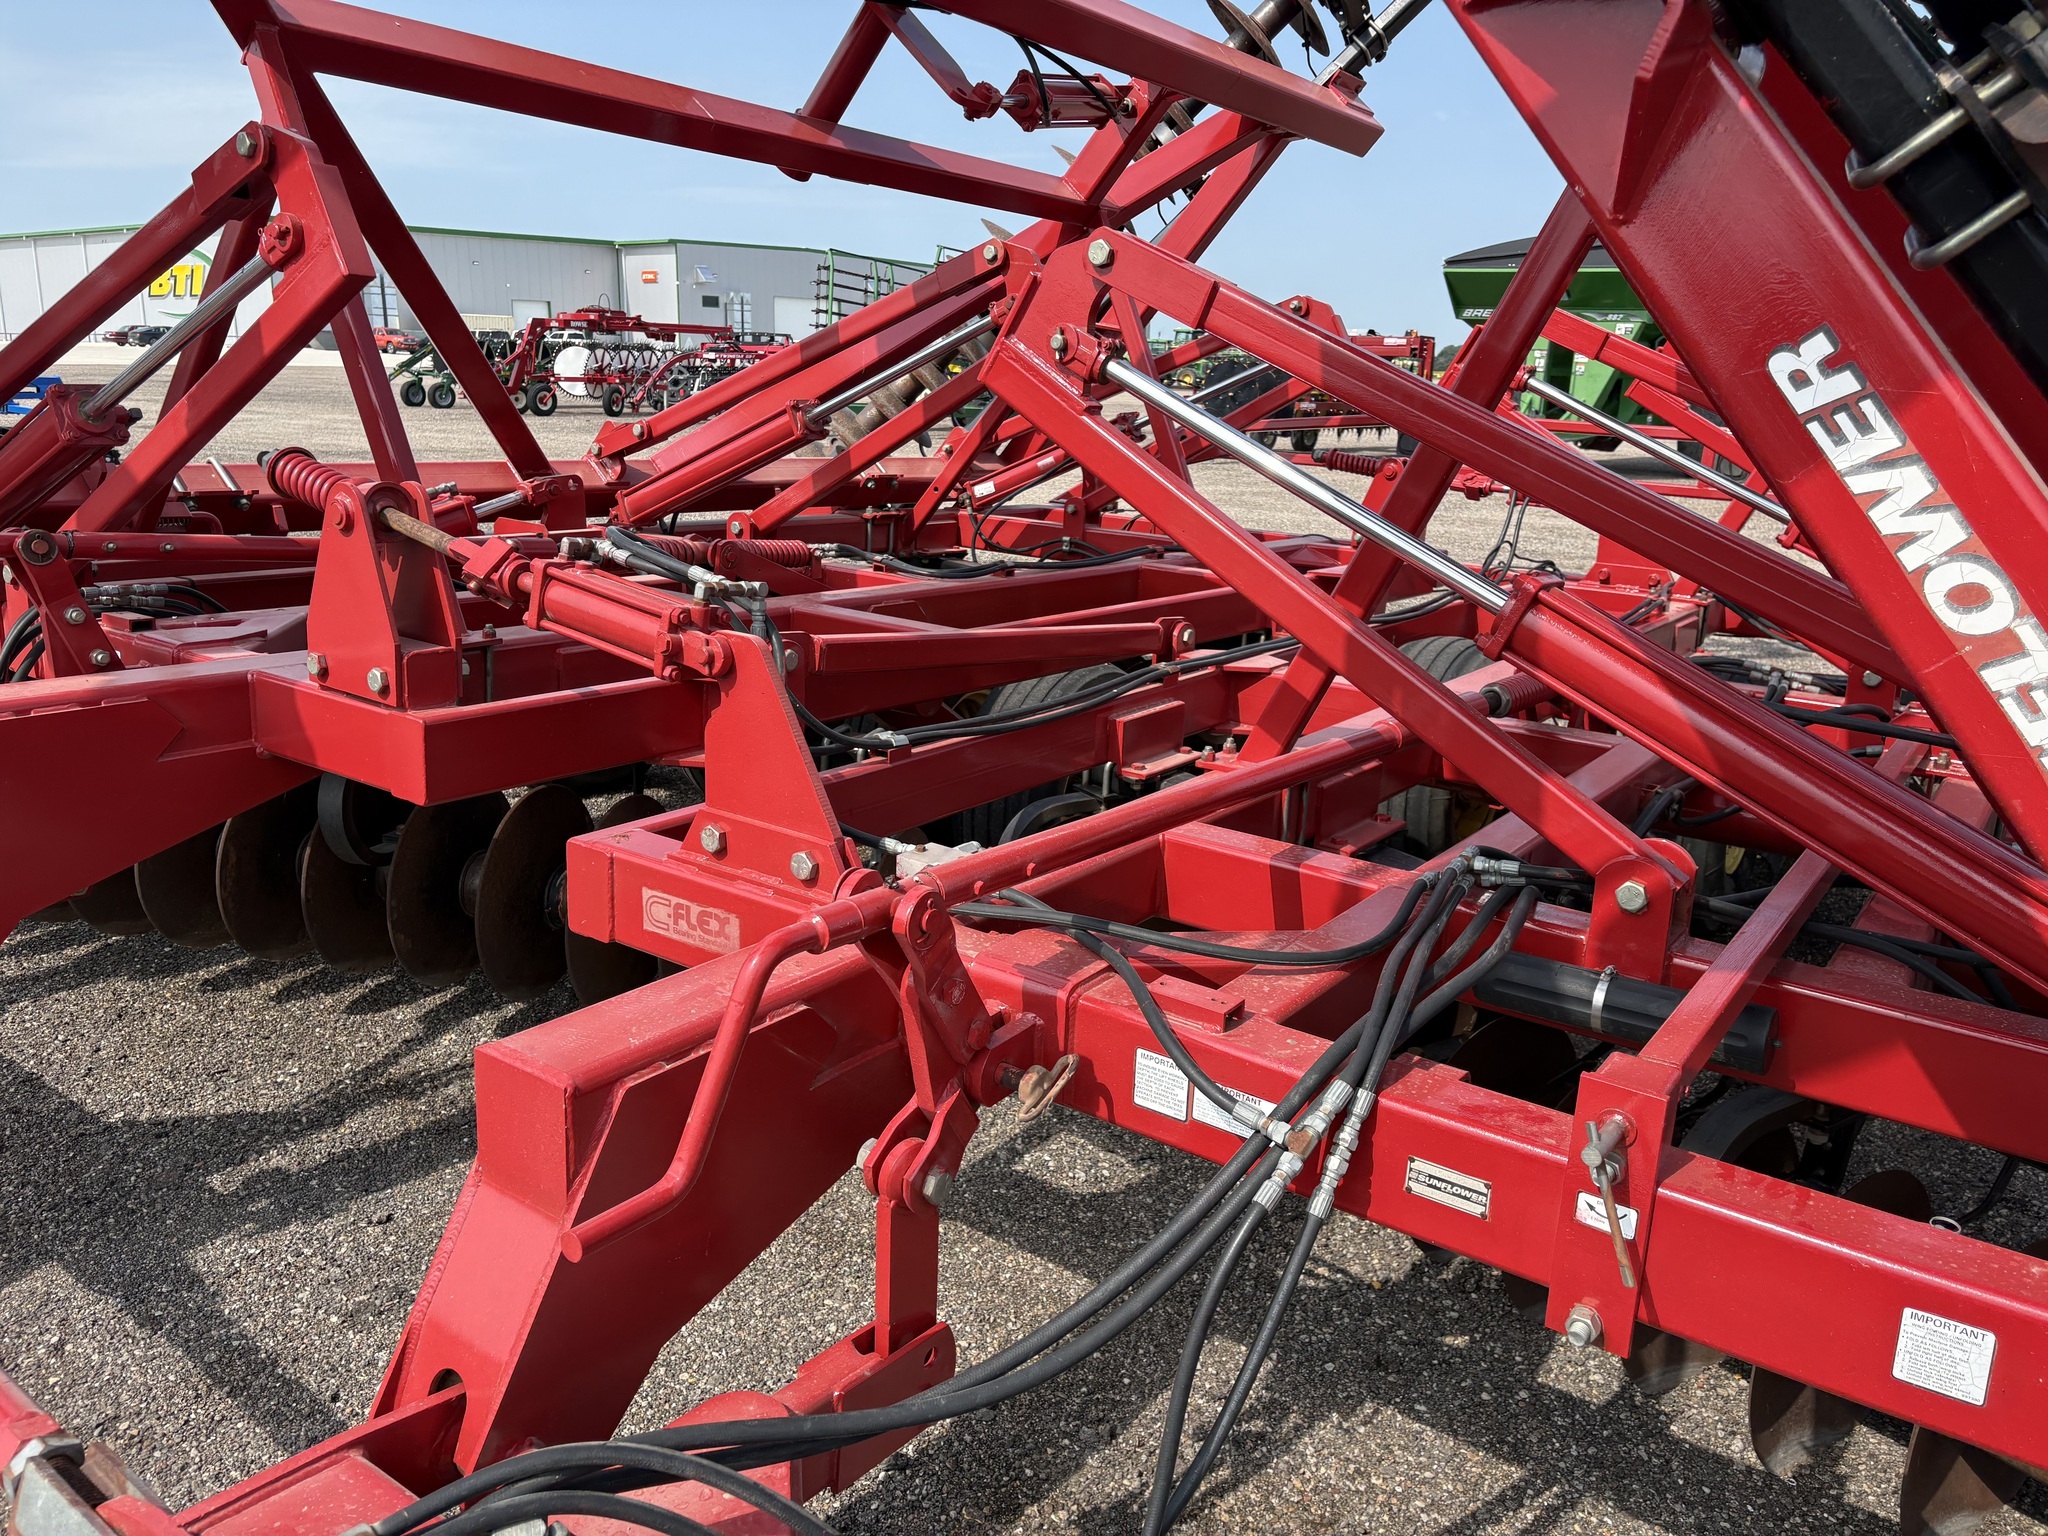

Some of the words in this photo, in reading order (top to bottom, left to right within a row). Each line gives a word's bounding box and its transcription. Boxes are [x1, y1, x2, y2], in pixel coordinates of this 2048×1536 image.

[148, 264, 205, 298] BTI
[1462, 308, 1494, 317] BRE
[1767, 322, 2048, 772] FLOWER
[1140, 1051, 1180, 1071] IMPORTAN
[1417, 1174, 1488, 1203] SUNFLOWER
[1910, 1311, 1988, 1341] IMPORTANT
